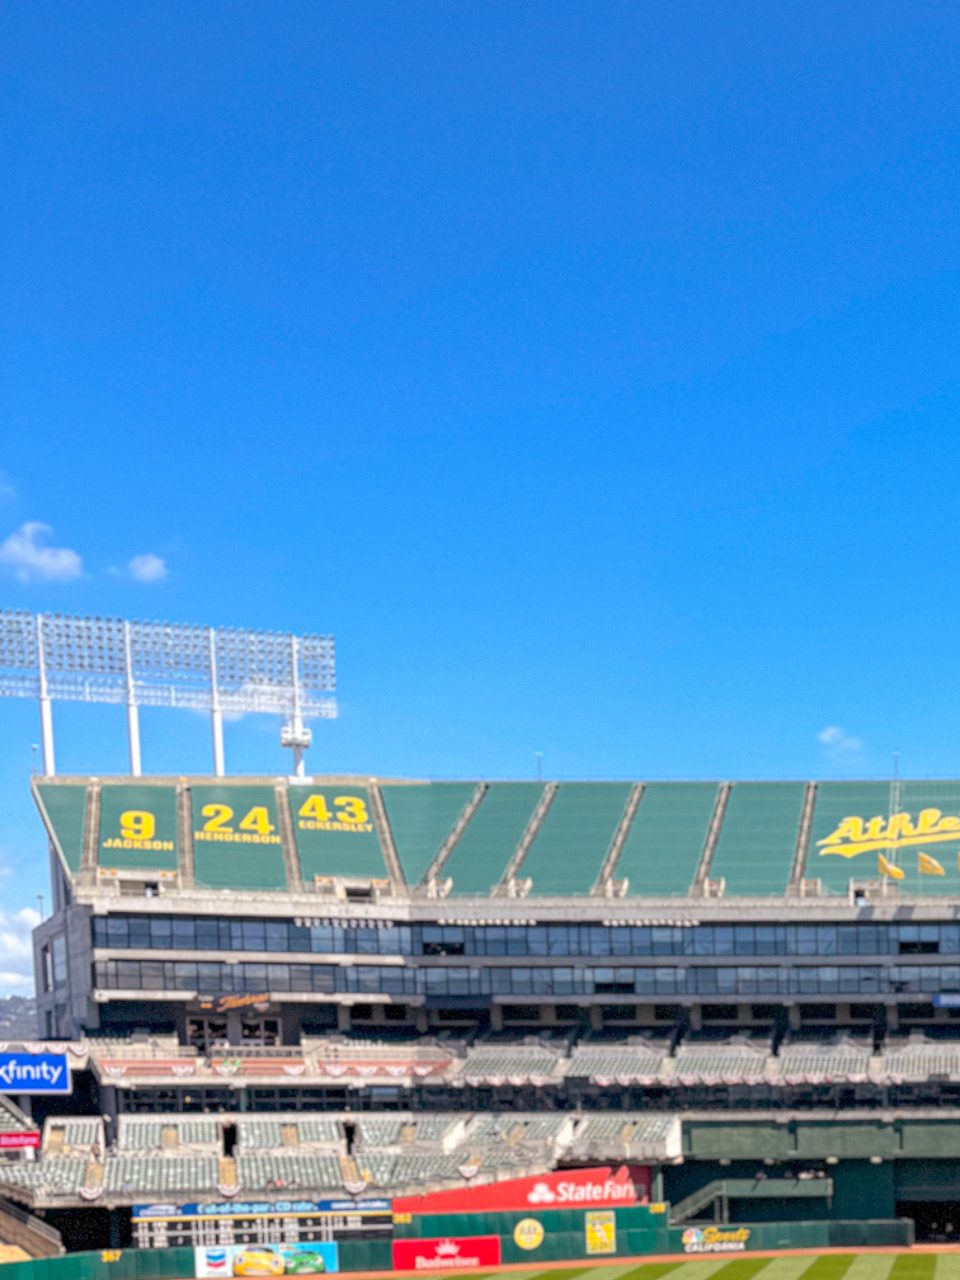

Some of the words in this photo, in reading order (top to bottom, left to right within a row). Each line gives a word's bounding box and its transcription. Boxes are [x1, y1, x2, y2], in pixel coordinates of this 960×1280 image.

[298, 795, 368, 823] 43
[120, 811, 155, 839] 9
[201, 804, 275, 834] 24
[298, 820, 373, 832] ECKERSLEY
[102, 838, 173, 851] JACKSON
[194, 831, 281, 844] HENDERSON
[415, 1256, 480, 1270] Budweiser
